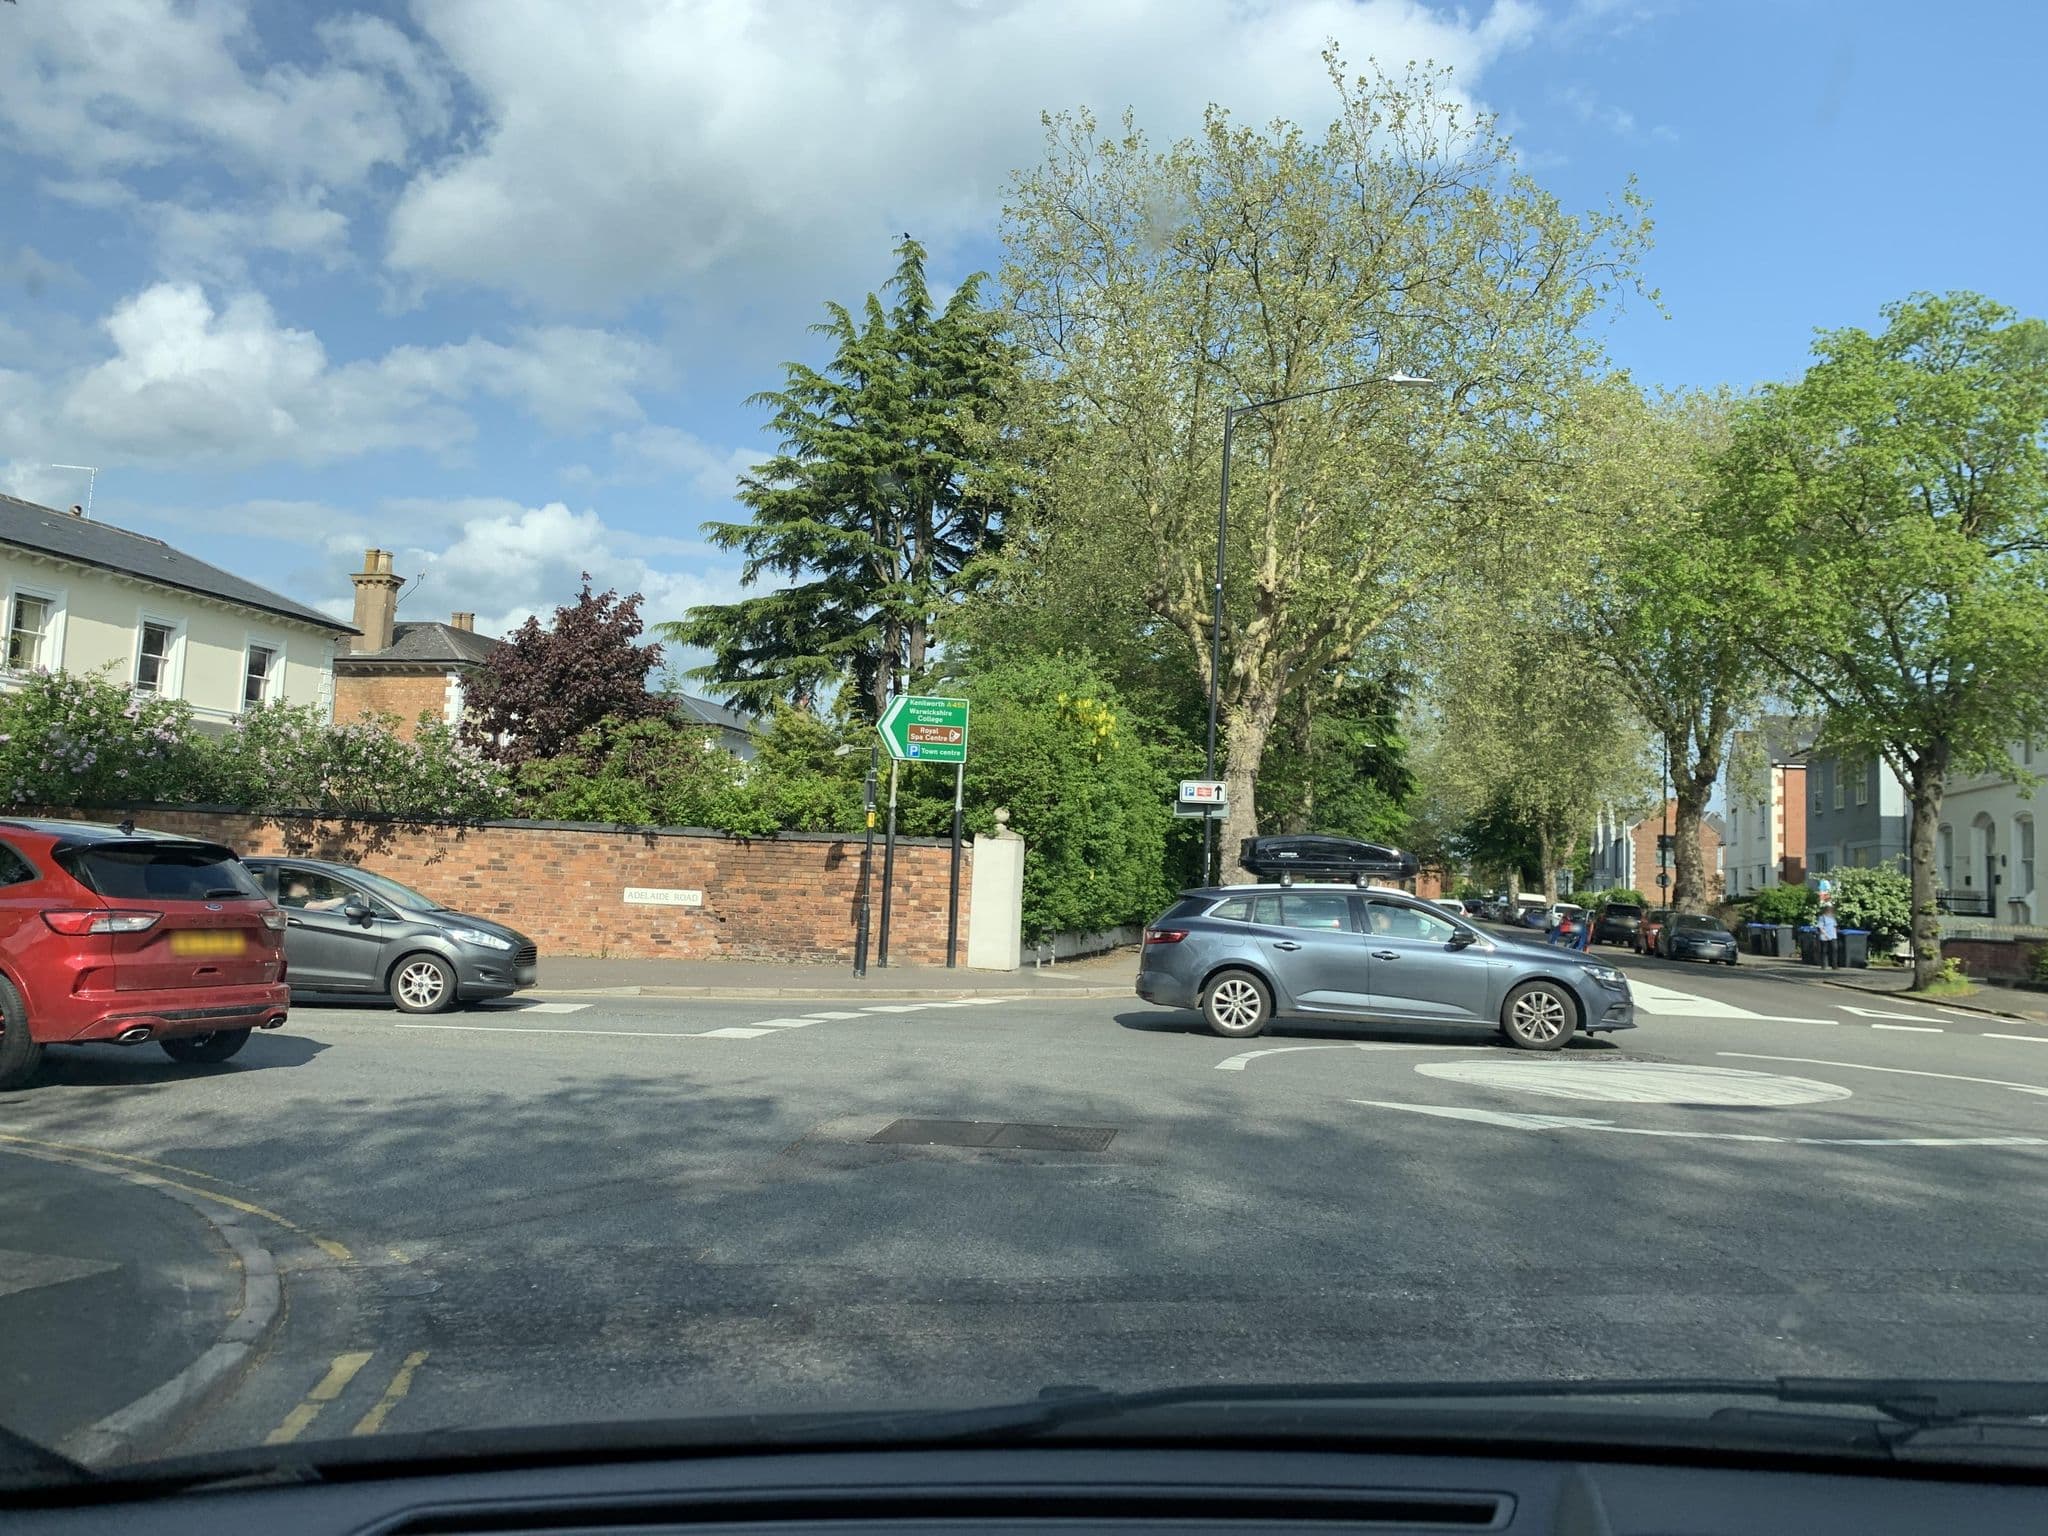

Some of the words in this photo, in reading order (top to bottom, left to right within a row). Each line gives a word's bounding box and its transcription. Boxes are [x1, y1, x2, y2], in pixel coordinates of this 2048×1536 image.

[910, 699, 945, 707] Kenilworth
[909, 708, 953, 717] Warwickshire
[917, 715, 944, 723] College
[920, 727, 939, 735] Royal
[910, 733, 923, 741] Spa
[925, 734, 948, 742] Centre
[627, 891, 670, 901] ADELAIDE
[673, 893, 698, 902] ROAD
